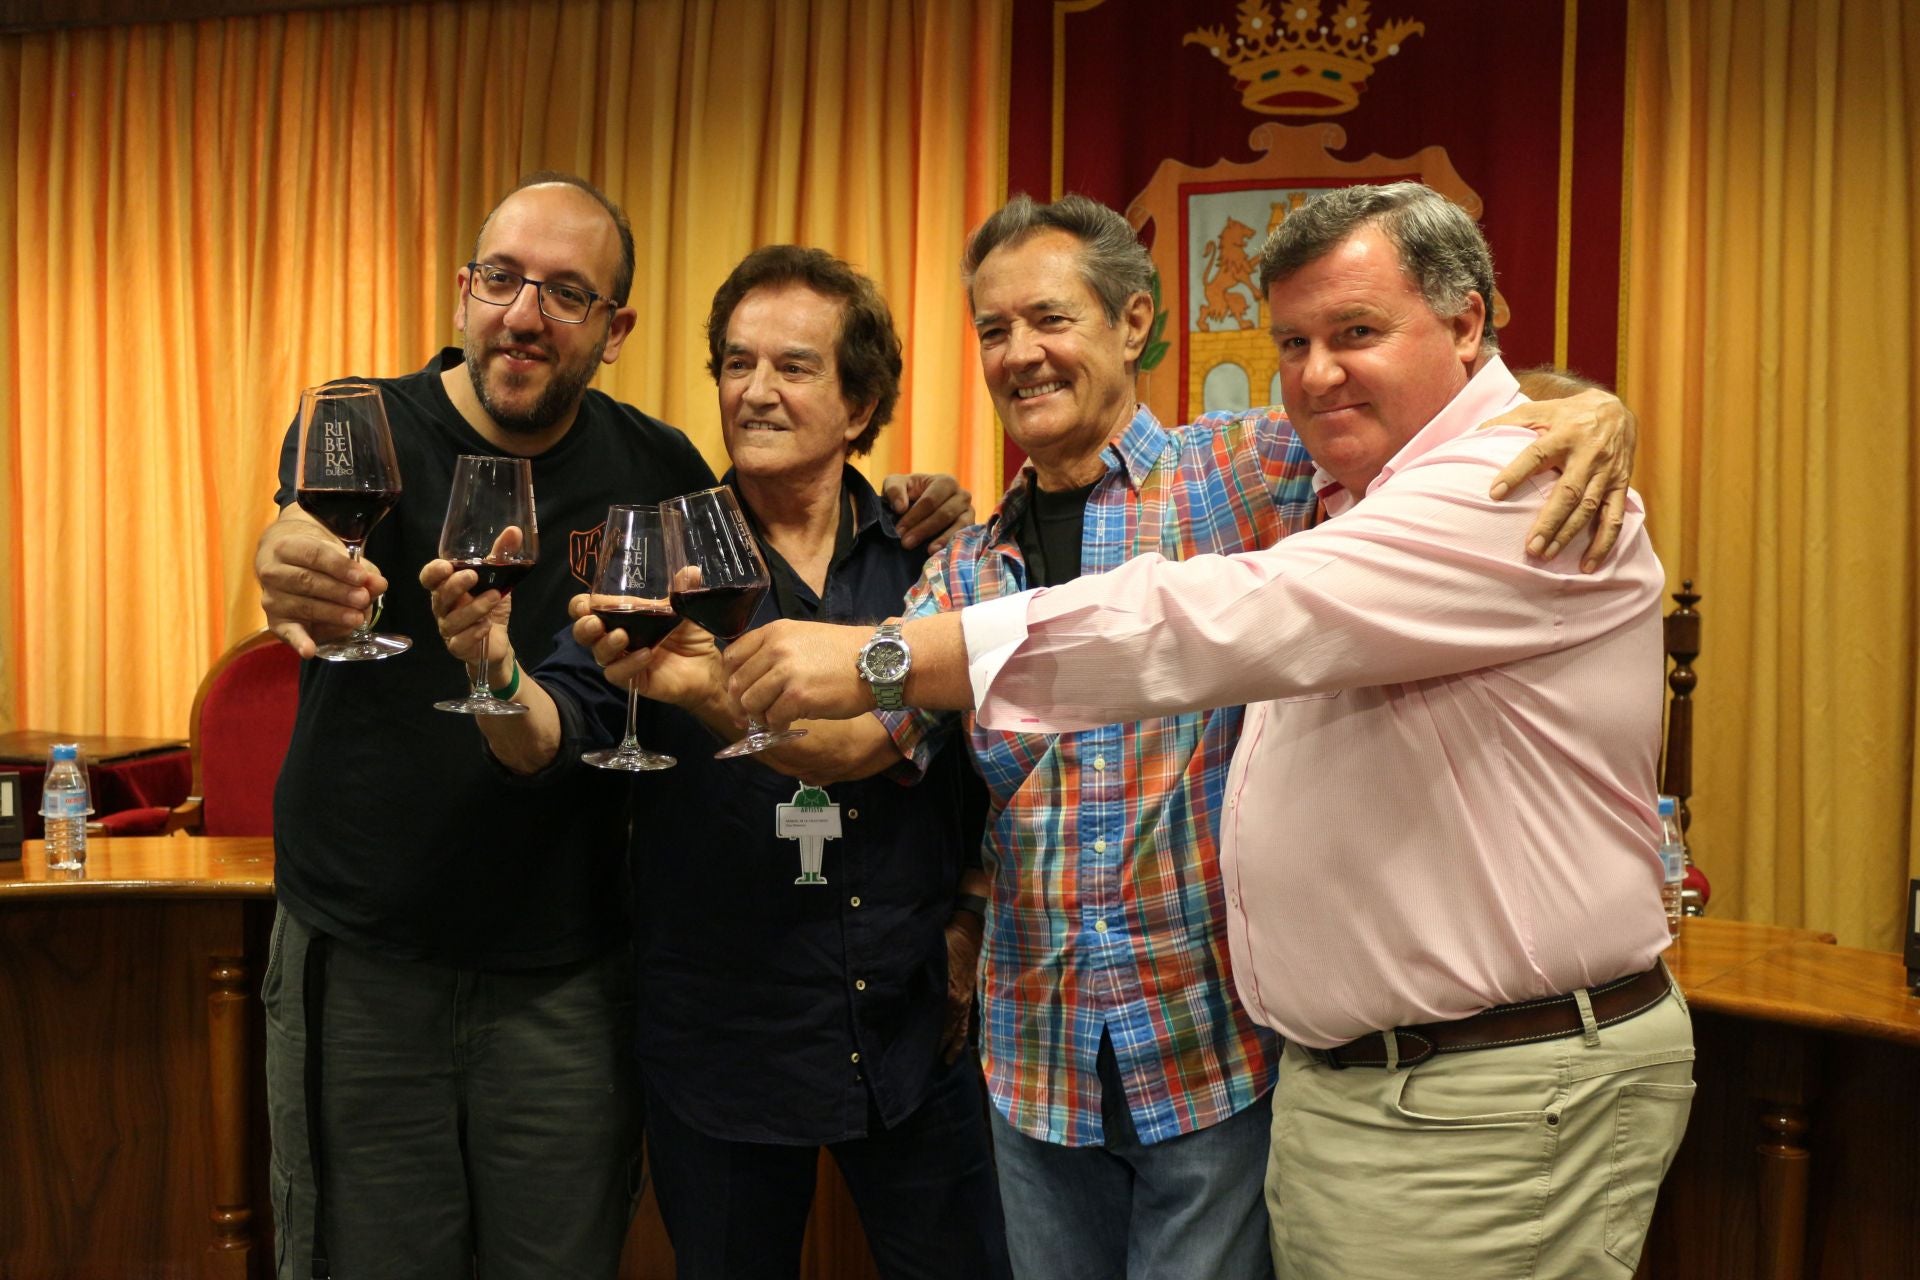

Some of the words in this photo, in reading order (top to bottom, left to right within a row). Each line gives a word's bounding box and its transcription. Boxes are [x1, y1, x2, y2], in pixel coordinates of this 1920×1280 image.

[324, 422, 343, 437] RI
[324, 437, 347, 452] BE
[324, 452, 351, 467] RA
